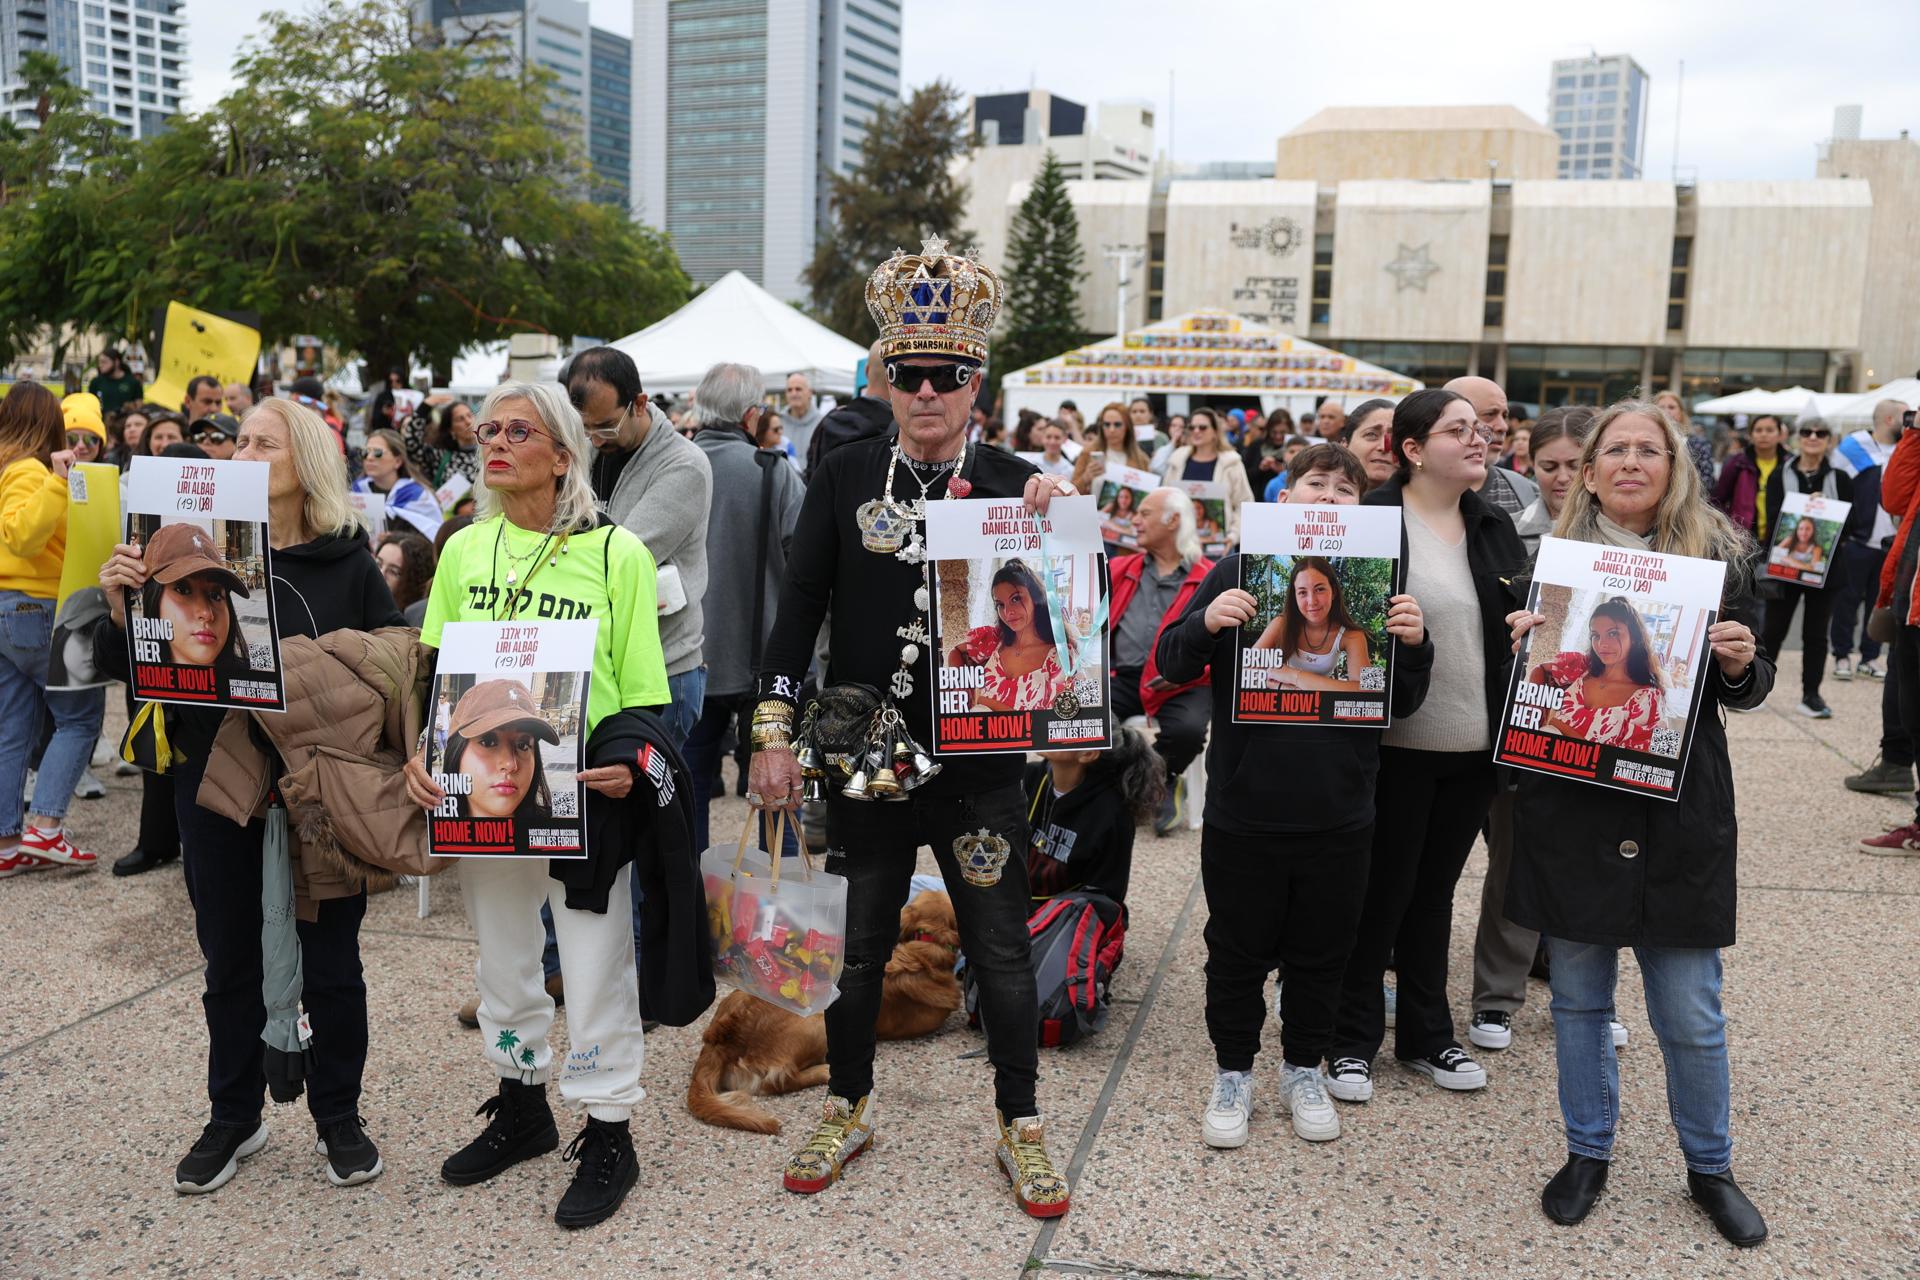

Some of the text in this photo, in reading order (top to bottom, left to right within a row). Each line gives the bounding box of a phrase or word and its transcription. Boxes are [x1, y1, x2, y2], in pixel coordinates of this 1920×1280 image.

[913, 340, 954, 350] SHARSHAR
[201, 466, 215, 480] לירי
[177, 481, 216, 496] LIRI ALBAG
[176, 497, 197, 512] (19)
[1304, 511, 1338, 523] נעמה לוי
[982, 521, 1020, 536] DANIELA
[1294, 524, 1346, 536] NAAMA LEVY
[994, 538, 1021, 552] (20)
[1319, 539, 1342, 552] (20)
[1601, 550, 1664, 569] דניאלה גלבוע
[1593, 560, 1667, 582] DANIELA GILBOA
[1602, 576, 1632, 591] (20)
[468, 577, 592, 620] אתם לא לבד
[132, 617, 174, 641] BRING
[523, 626, 539, 640] לירי
[134, 639, 162, 663] HER
[496, 640, 538, 654] LIRI ALBAG
[495, 656, 518, 668] (19)
[1242, 648, 1284, 668] BRING
[136, 665, 216, 692] HOME NOW!
[938, 665, 986, 690] BRING
[1241, 668, 1268, 689] HER
[230, 686, 278, 701] FAMILIES FORUM
[940, 691, 970, 714] HER
[1240, 690, 1320, 714] HOME NOW!
[1514, 680, 1565, 710] BRING
[1334, 707, 1384, 718] FAMILIES FORUM
[1509, 703, 1543, 730] HER
[940, 712, 1032, 741] HOME NOW!
[1048, 726, 1104, 740] FAMILIES FORUM
[1504, 729, 1601, 770] HOME NOW!
[1615, 759, 1642, 771] HOSTAGES
[1641, 764, 1652, 772] AND
[432, 772, 473, 796] BRING
[1614, 766, 1674, 789] FAMILIES FORUM
[434, 796, 459, 818] HER
[434, 819, 514, 843] HOME NOW!
[529, 836, 580, 847] FAMILIES FORUM
